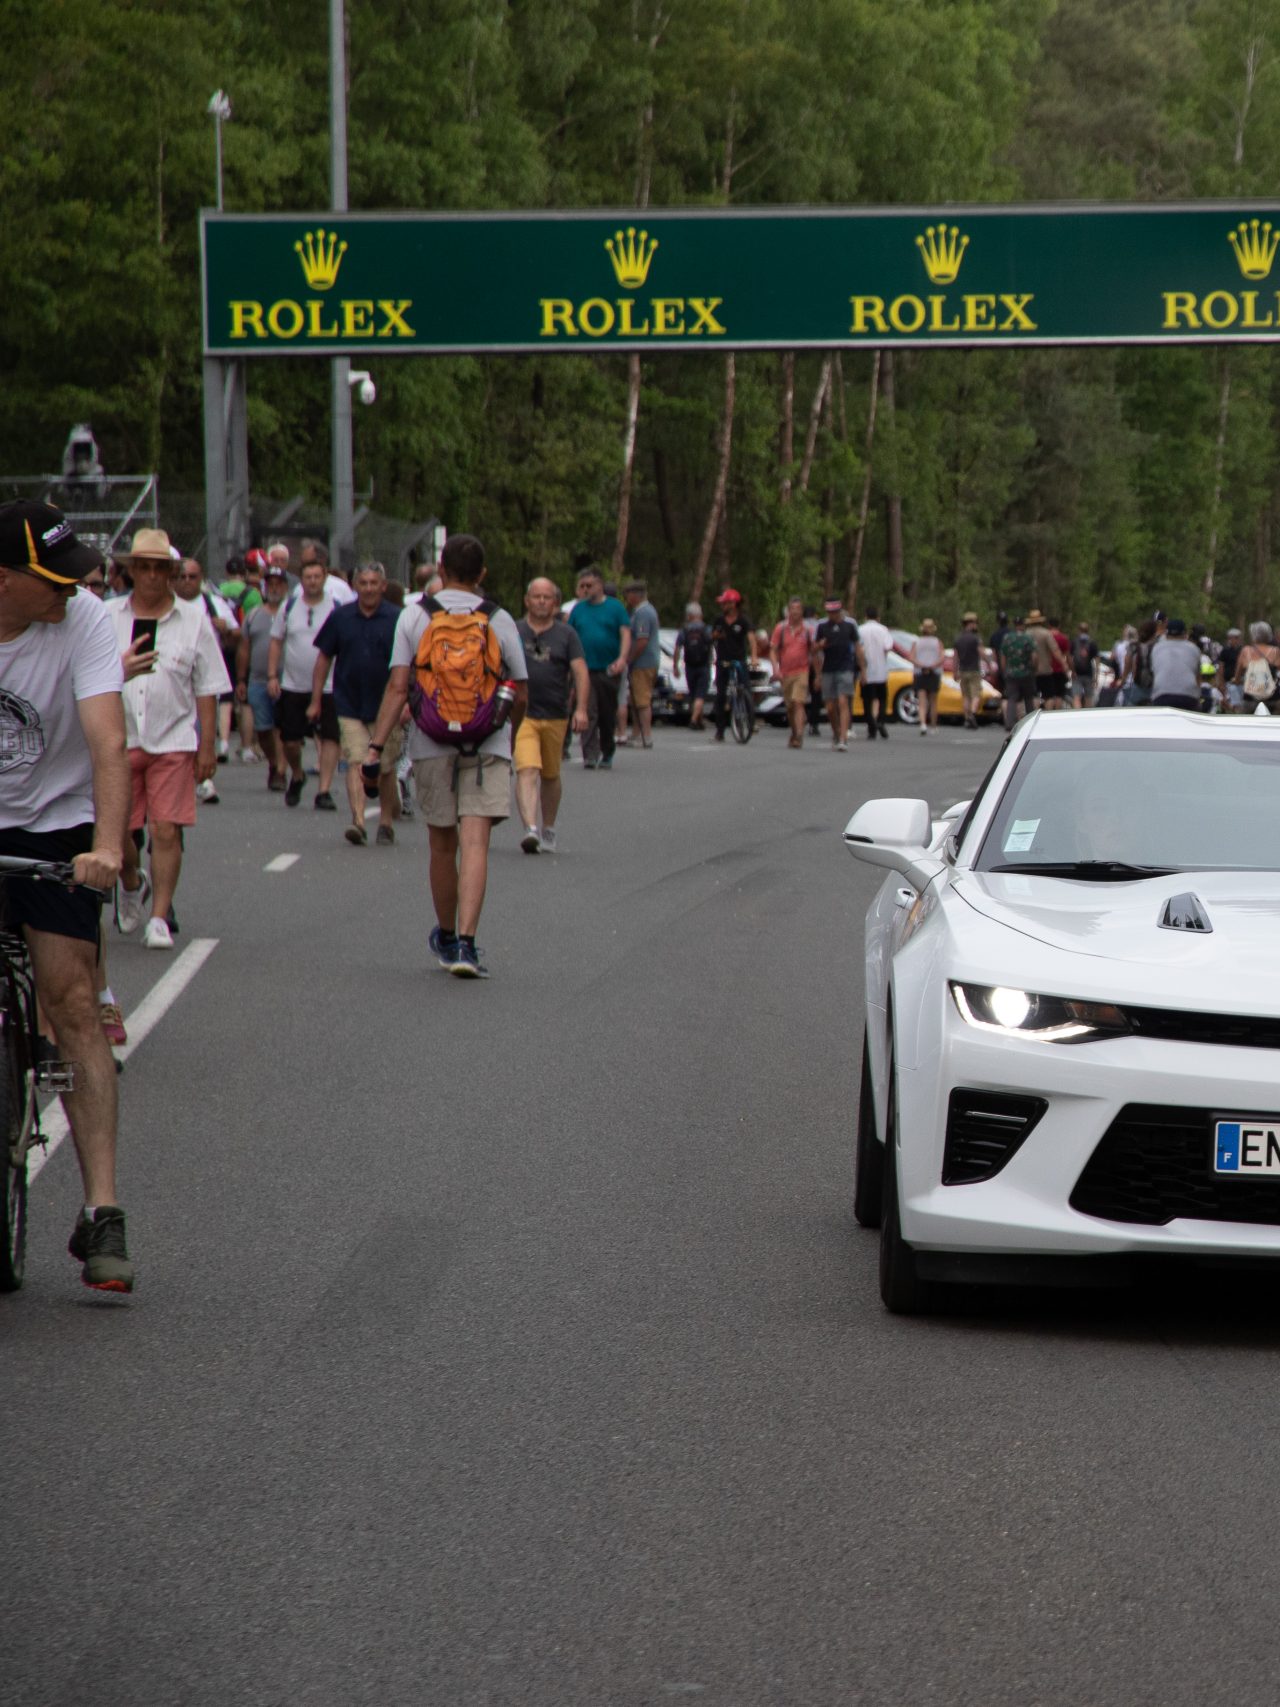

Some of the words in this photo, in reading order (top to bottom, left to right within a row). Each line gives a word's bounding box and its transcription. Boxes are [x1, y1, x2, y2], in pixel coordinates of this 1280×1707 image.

[230, 299, 416, 339] ROLEX
[540, 297, 726, 337] ROLEX
[851, 294, 1036, 333] ROLEX
[0, 729, 43, 756] BU
[1223, 1152, 1232, 1163] F
